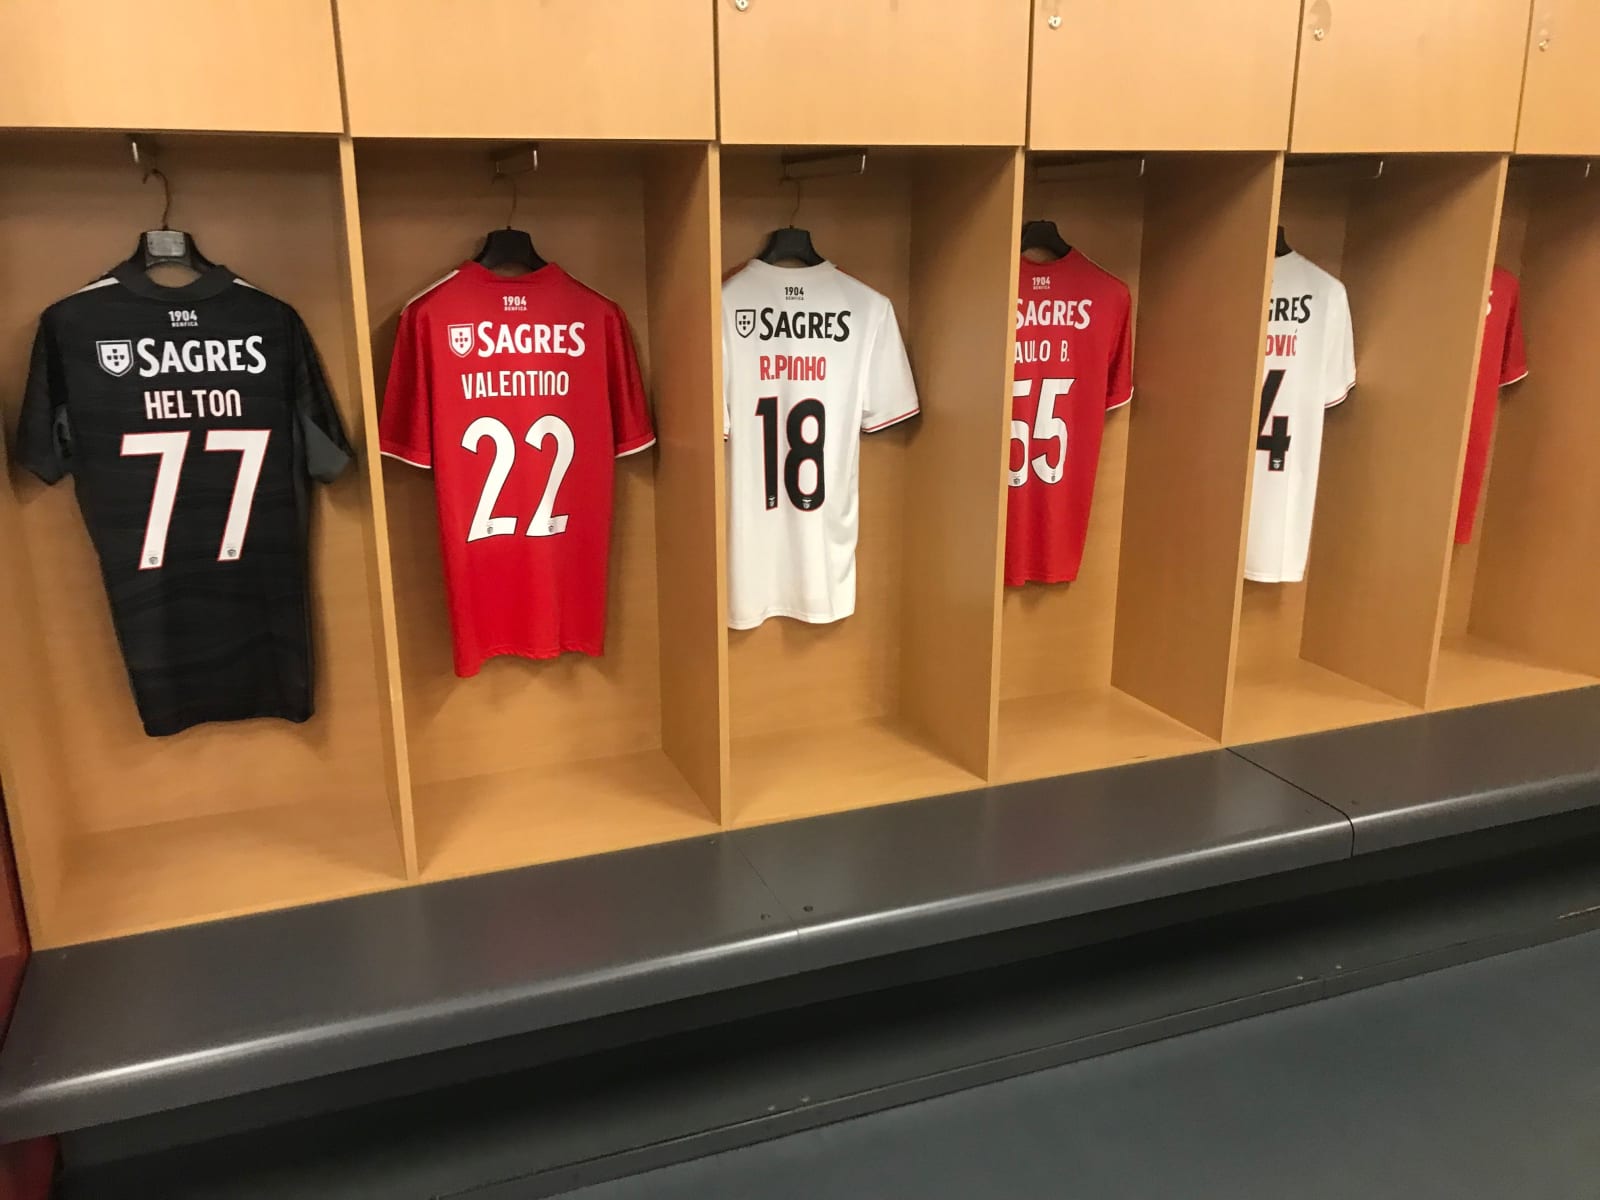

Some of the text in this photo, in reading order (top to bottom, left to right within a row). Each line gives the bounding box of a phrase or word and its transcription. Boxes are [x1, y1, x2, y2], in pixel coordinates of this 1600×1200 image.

[785, 287, 804, 295] 1904
[1032, 277, 1050, 285] 1904
[502, 296, 527, 305] 1904
[1268, 294, 1312, 323] RES
[168, 310, 197, 321] 1904
[760, 307, 851, 342] SAGRES
[477, 321, 586, 358] SAGRES
[137, 335, 268, 377] SAGRES
[760, 355, 826, 380] R.PINHO
[461, 370, 570, 399] VALENTINO
[755, 396, 825, 512] 18
[461, 414, 575, 543] 22
[120, 429, 272, 570] 77
